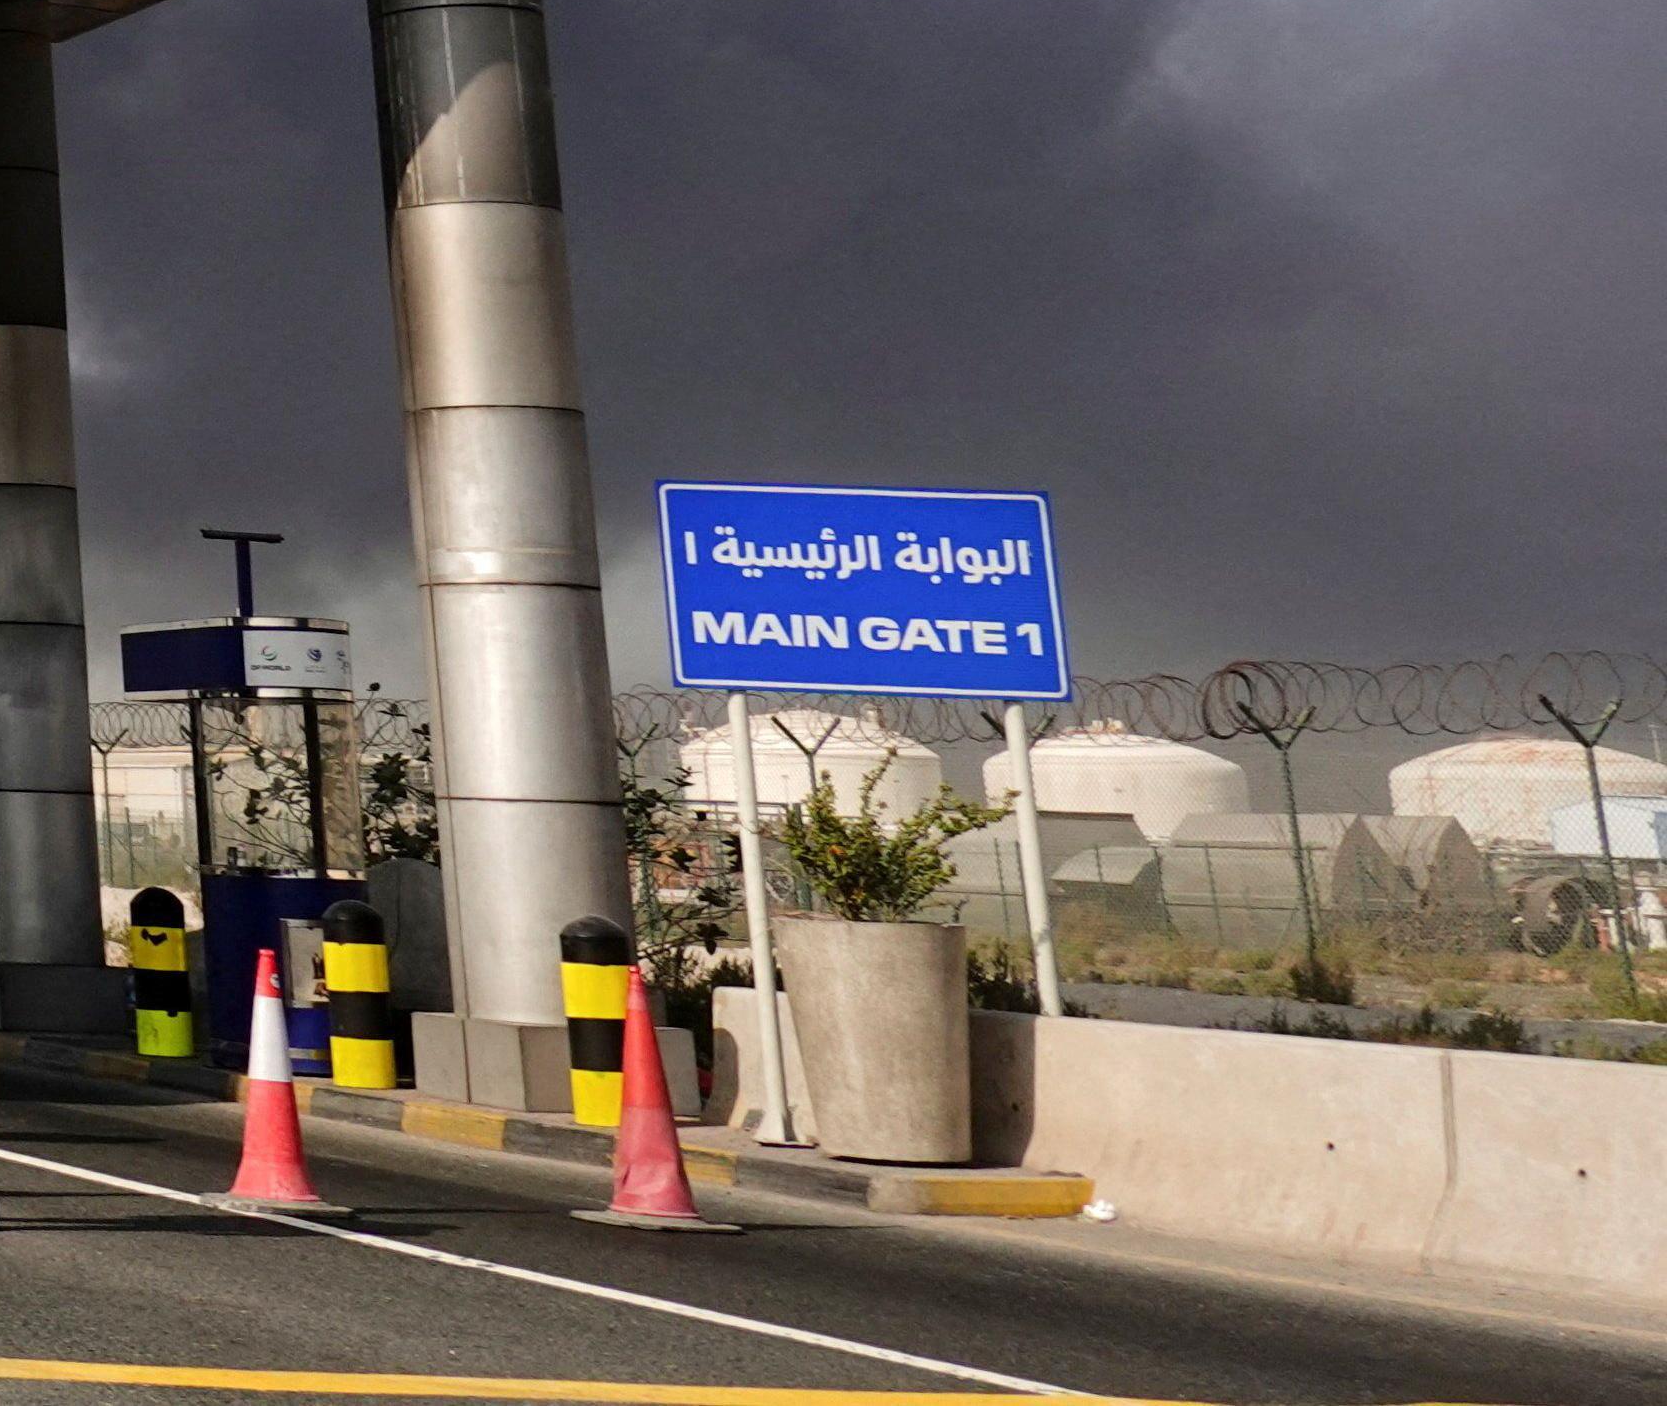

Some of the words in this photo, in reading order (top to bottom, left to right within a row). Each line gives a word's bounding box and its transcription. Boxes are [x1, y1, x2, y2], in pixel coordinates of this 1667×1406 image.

[711, 526, 883, 581] الرئيسية
[894, 530, 1033, 585] البوابة
[691, 610, 850, 650] MAIN
[858, 616, 1009, 655] GATE
[1016, 622, 1044, 656] 1
